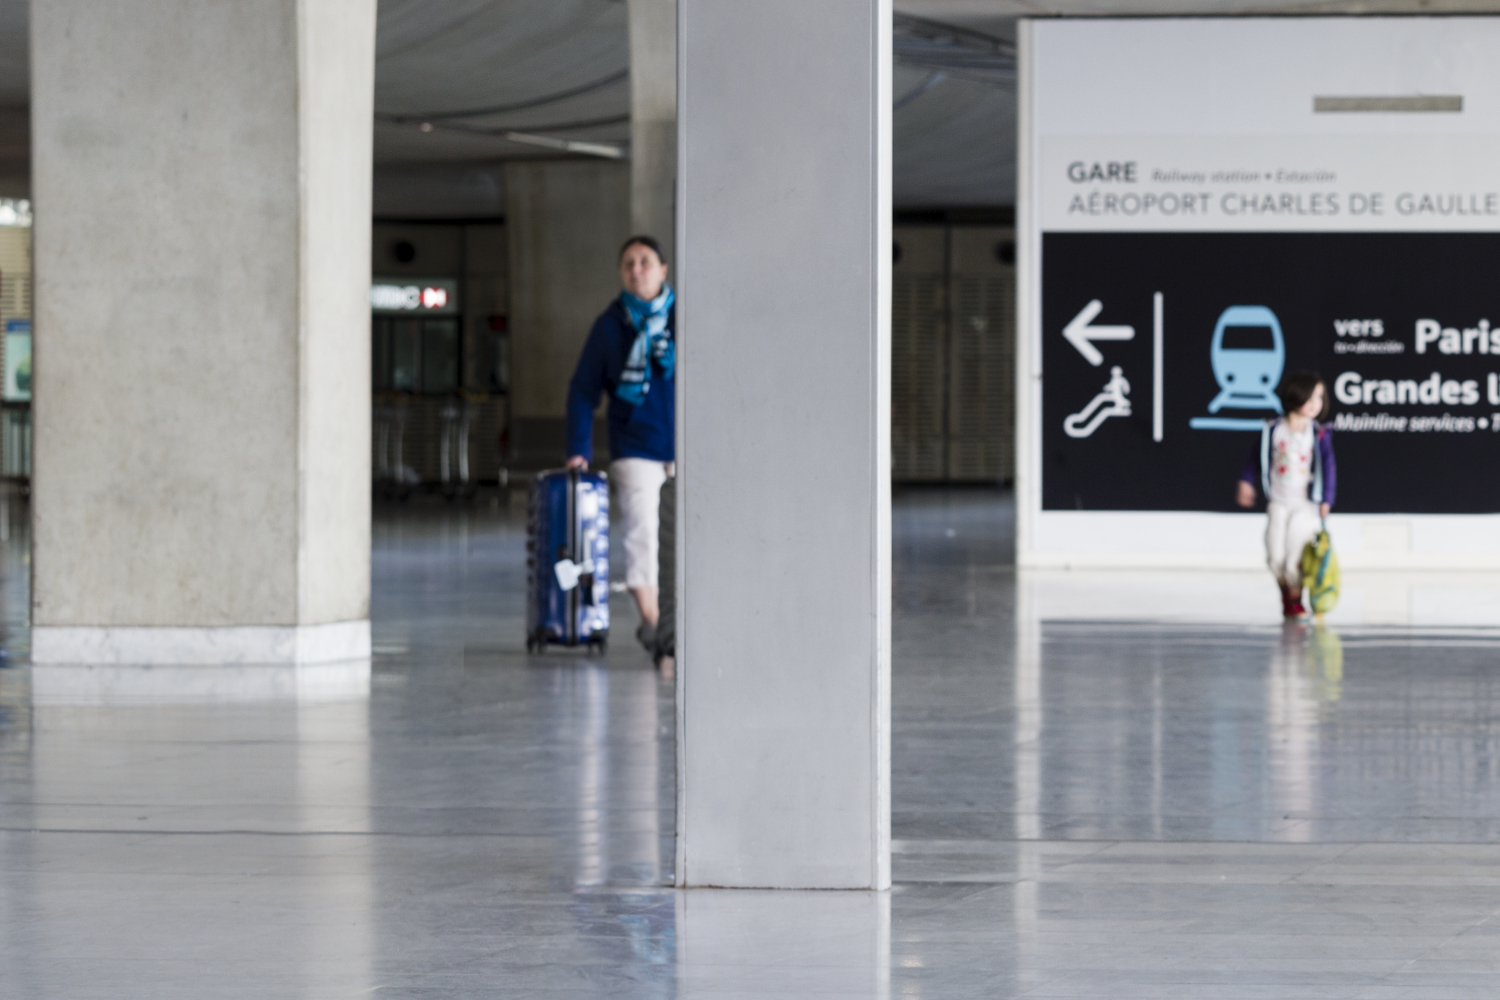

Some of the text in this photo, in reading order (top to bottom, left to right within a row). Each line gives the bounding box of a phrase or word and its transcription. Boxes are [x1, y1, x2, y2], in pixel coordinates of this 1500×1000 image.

[1066, 160, 1138, 184] GARE
[1067, 189, 1212, 216] AÉROPORT
[1220, 192, 1340, 216] CHARLES
[1349, 192, 1383, 215] DE
[1395, 192, 1498, 216] GAULLE
[1334, 320, 1384, 337] vers
[1335, 372, 1479, 405] Grandes
[1334, 413, 1408, 431] Mainline
[1409, 414, 1475, 432] services
